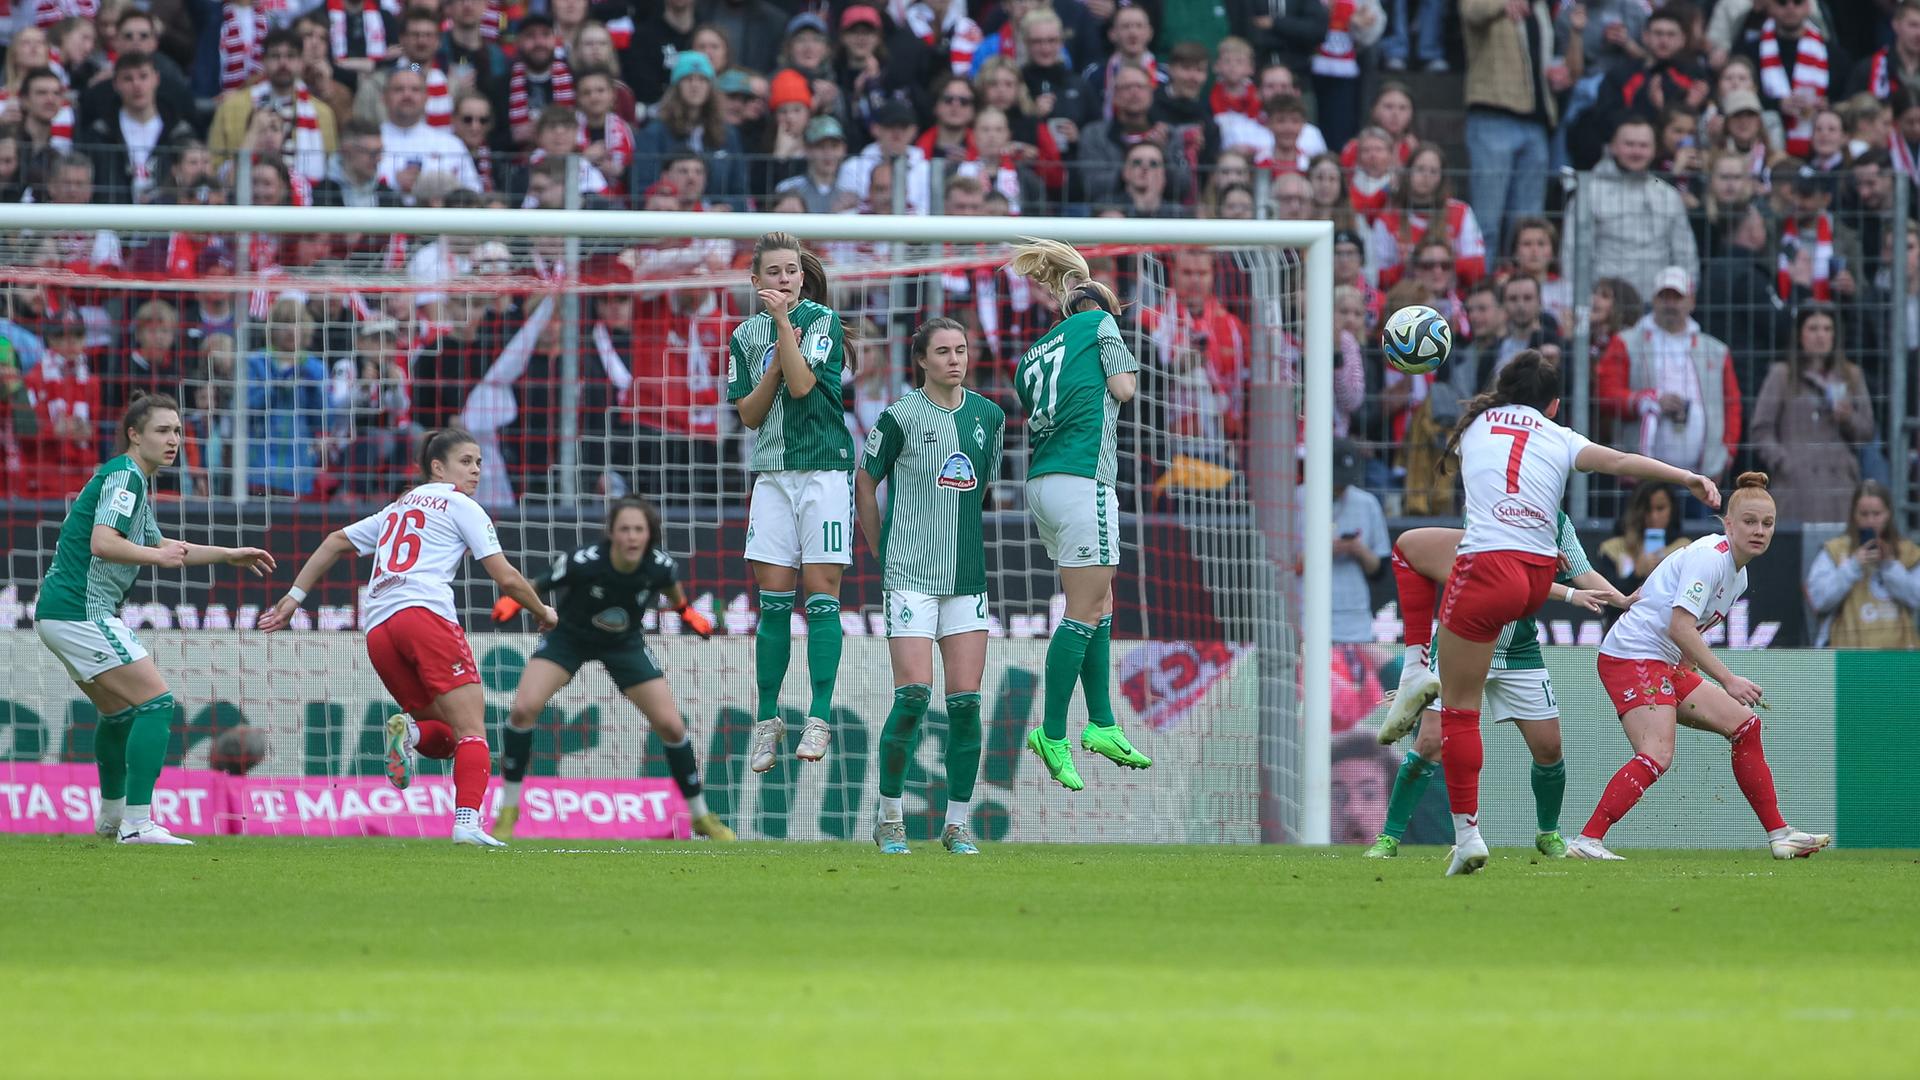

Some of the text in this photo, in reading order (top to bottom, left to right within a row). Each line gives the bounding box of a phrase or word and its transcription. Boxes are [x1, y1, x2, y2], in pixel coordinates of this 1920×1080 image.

[1023, 345, 1066, 433] 27
[1490, 425, 1530, 494] 7
[822, 520, 842, 553] 10
[1693, 581, 1704, 593] G
[61, 784, 208, 825] SRT
[293, 786, 504, 822] MAGEN
[523, 787, 672, 824] SPORT
